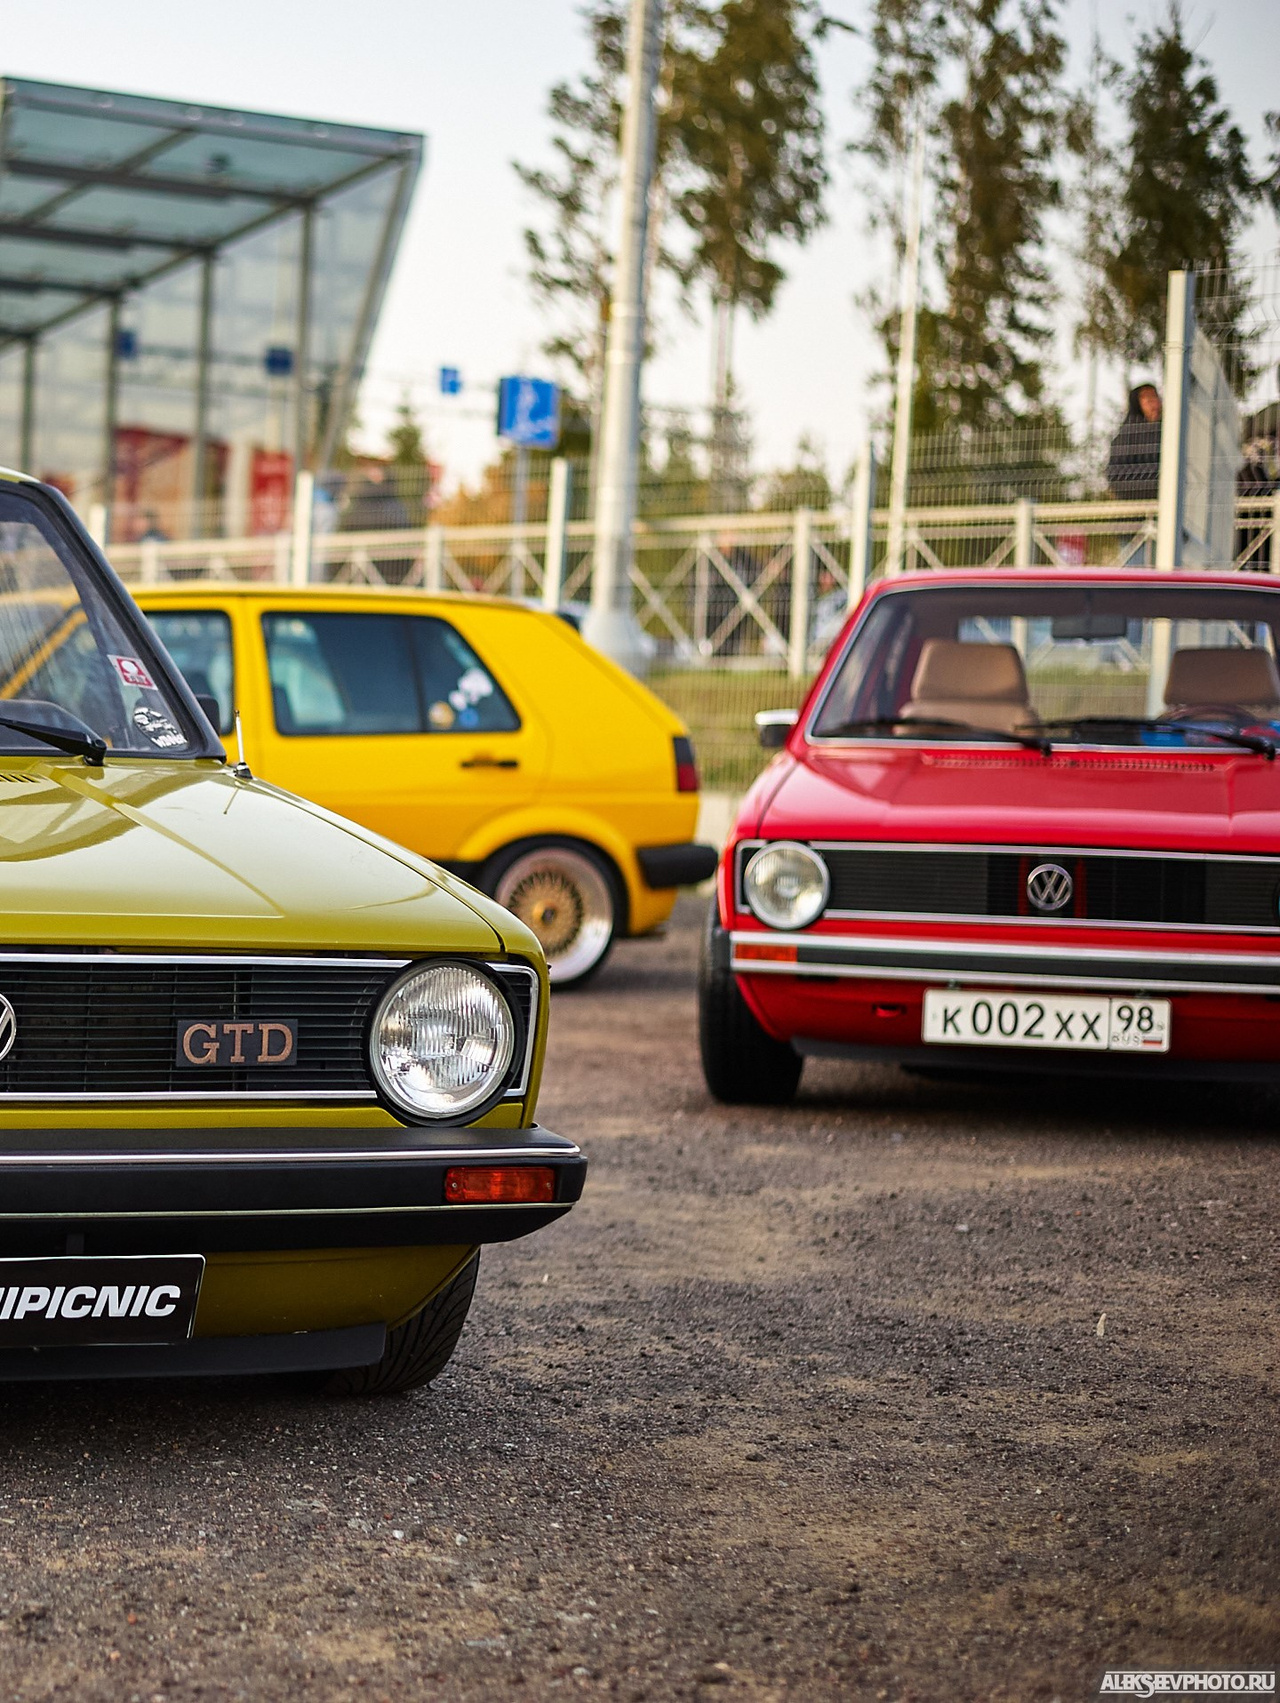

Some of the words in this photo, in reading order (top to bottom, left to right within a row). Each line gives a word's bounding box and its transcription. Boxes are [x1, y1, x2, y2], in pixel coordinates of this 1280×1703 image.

[1028, 865, 1072, 909] VW
[1117, 1005, 1153, 1032] 98
[182, 1023, 294, 1065] GTD
